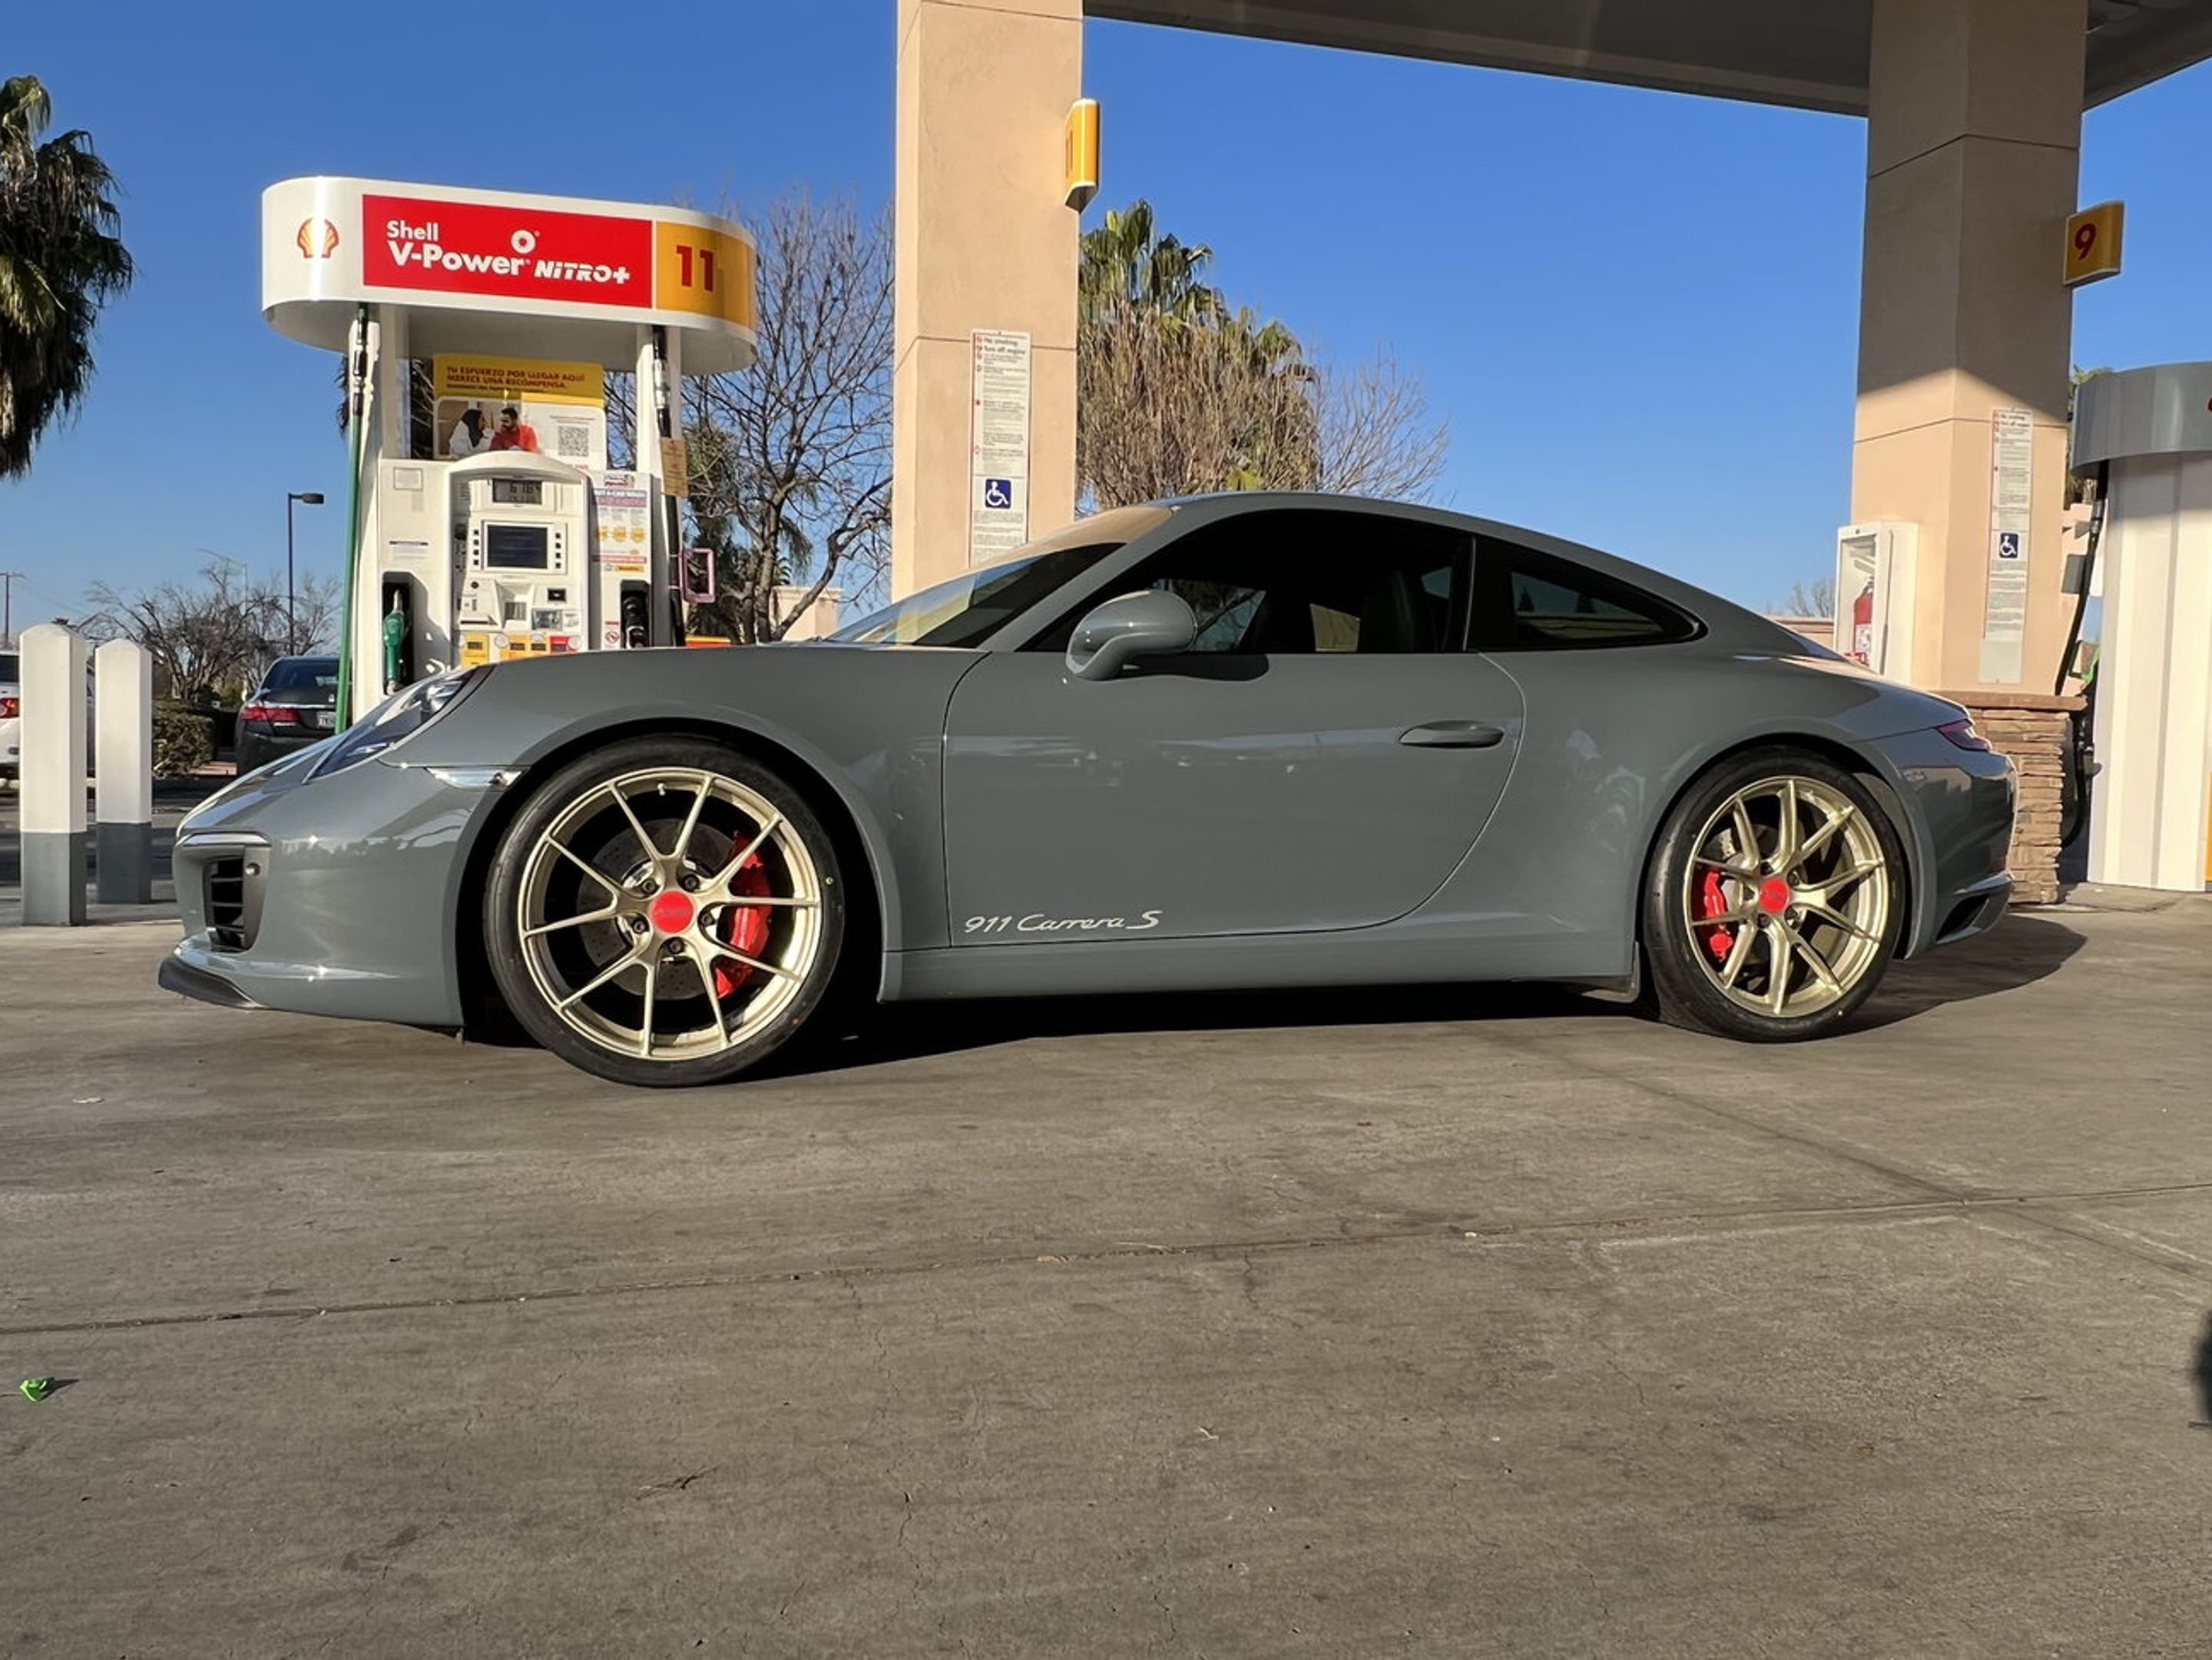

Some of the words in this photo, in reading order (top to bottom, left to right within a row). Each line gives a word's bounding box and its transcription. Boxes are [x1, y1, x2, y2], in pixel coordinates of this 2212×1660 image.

[387, 220, 439, 241] Shell
[2075, 224, 2097, 260] 9
[388, 240, 525, 276] V-Power
[535, 259, 631, 284] NITRO+
[677, 245, 714, 292] 11
[483, 376, 503, 385] UNA
[965, 916, 1012, 933] 911
[1017, 913, 1125, 931] Carrera
[1125, 910, 1164, 929] S
